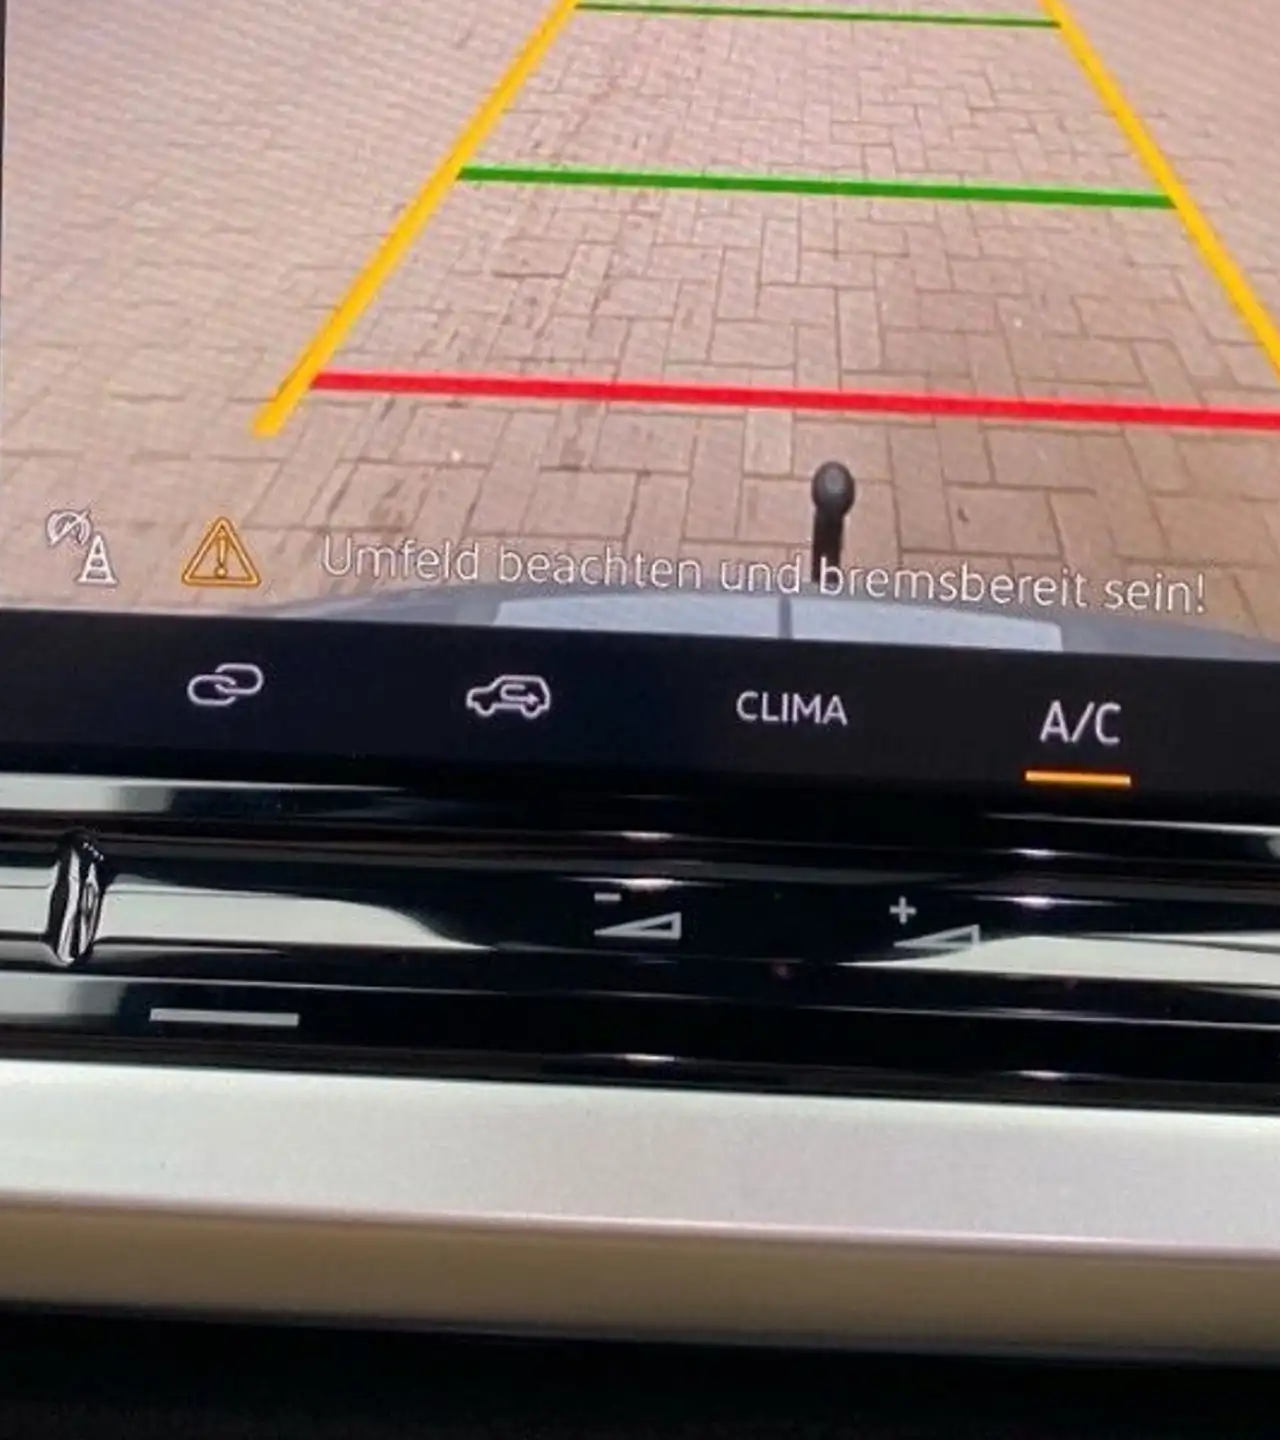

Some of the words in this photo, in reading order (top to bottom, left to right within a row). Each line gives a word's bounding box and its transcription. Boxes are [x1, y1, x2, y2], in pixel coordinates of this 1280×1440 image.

[322, 534, 480, 582] Umfeld
[498, 545, 702, 590] beachten
[721, 554, 801, 594] und
[819, 555, 1089, 610] bremsbereit
[1103, 570, 1207, 614] sein!
[735, 690, 849, 727] CLIMA
[1039, 699, 1122, 747] A/C
